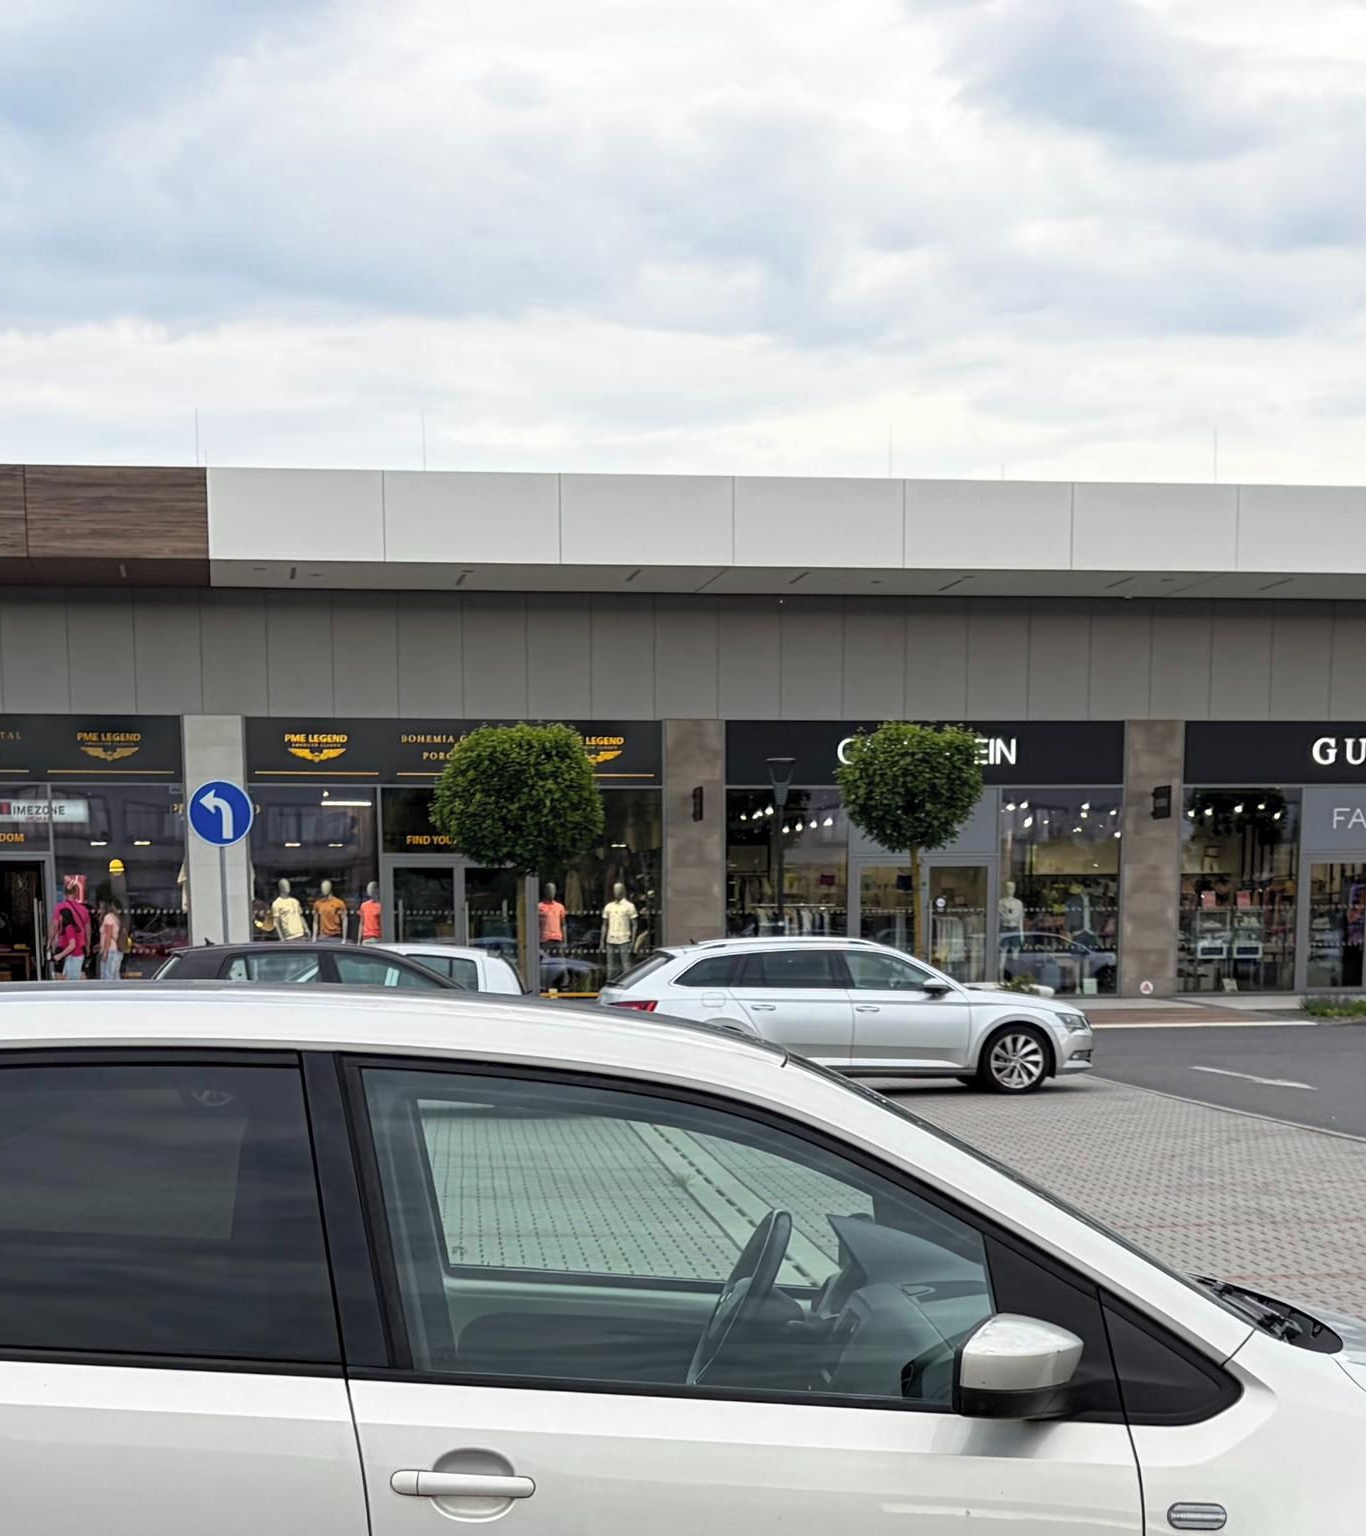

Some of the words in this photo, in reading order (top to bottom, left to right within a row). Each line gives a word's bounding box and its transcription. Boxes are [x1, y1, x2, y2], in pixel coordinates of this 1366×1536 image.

[77, 732, 100, 741] PME
[101, 732, 141, 741] LEGEND
[284, 733, 307, 743] PME
[308, 734, 348, 743] LEGEND
[401, 734, 455, 743] BOHEMIA
[585, 736, 625, 745] LEGEND
[406, 835, 431, 845] FIND
[431, 835, 454, 845] YOU
